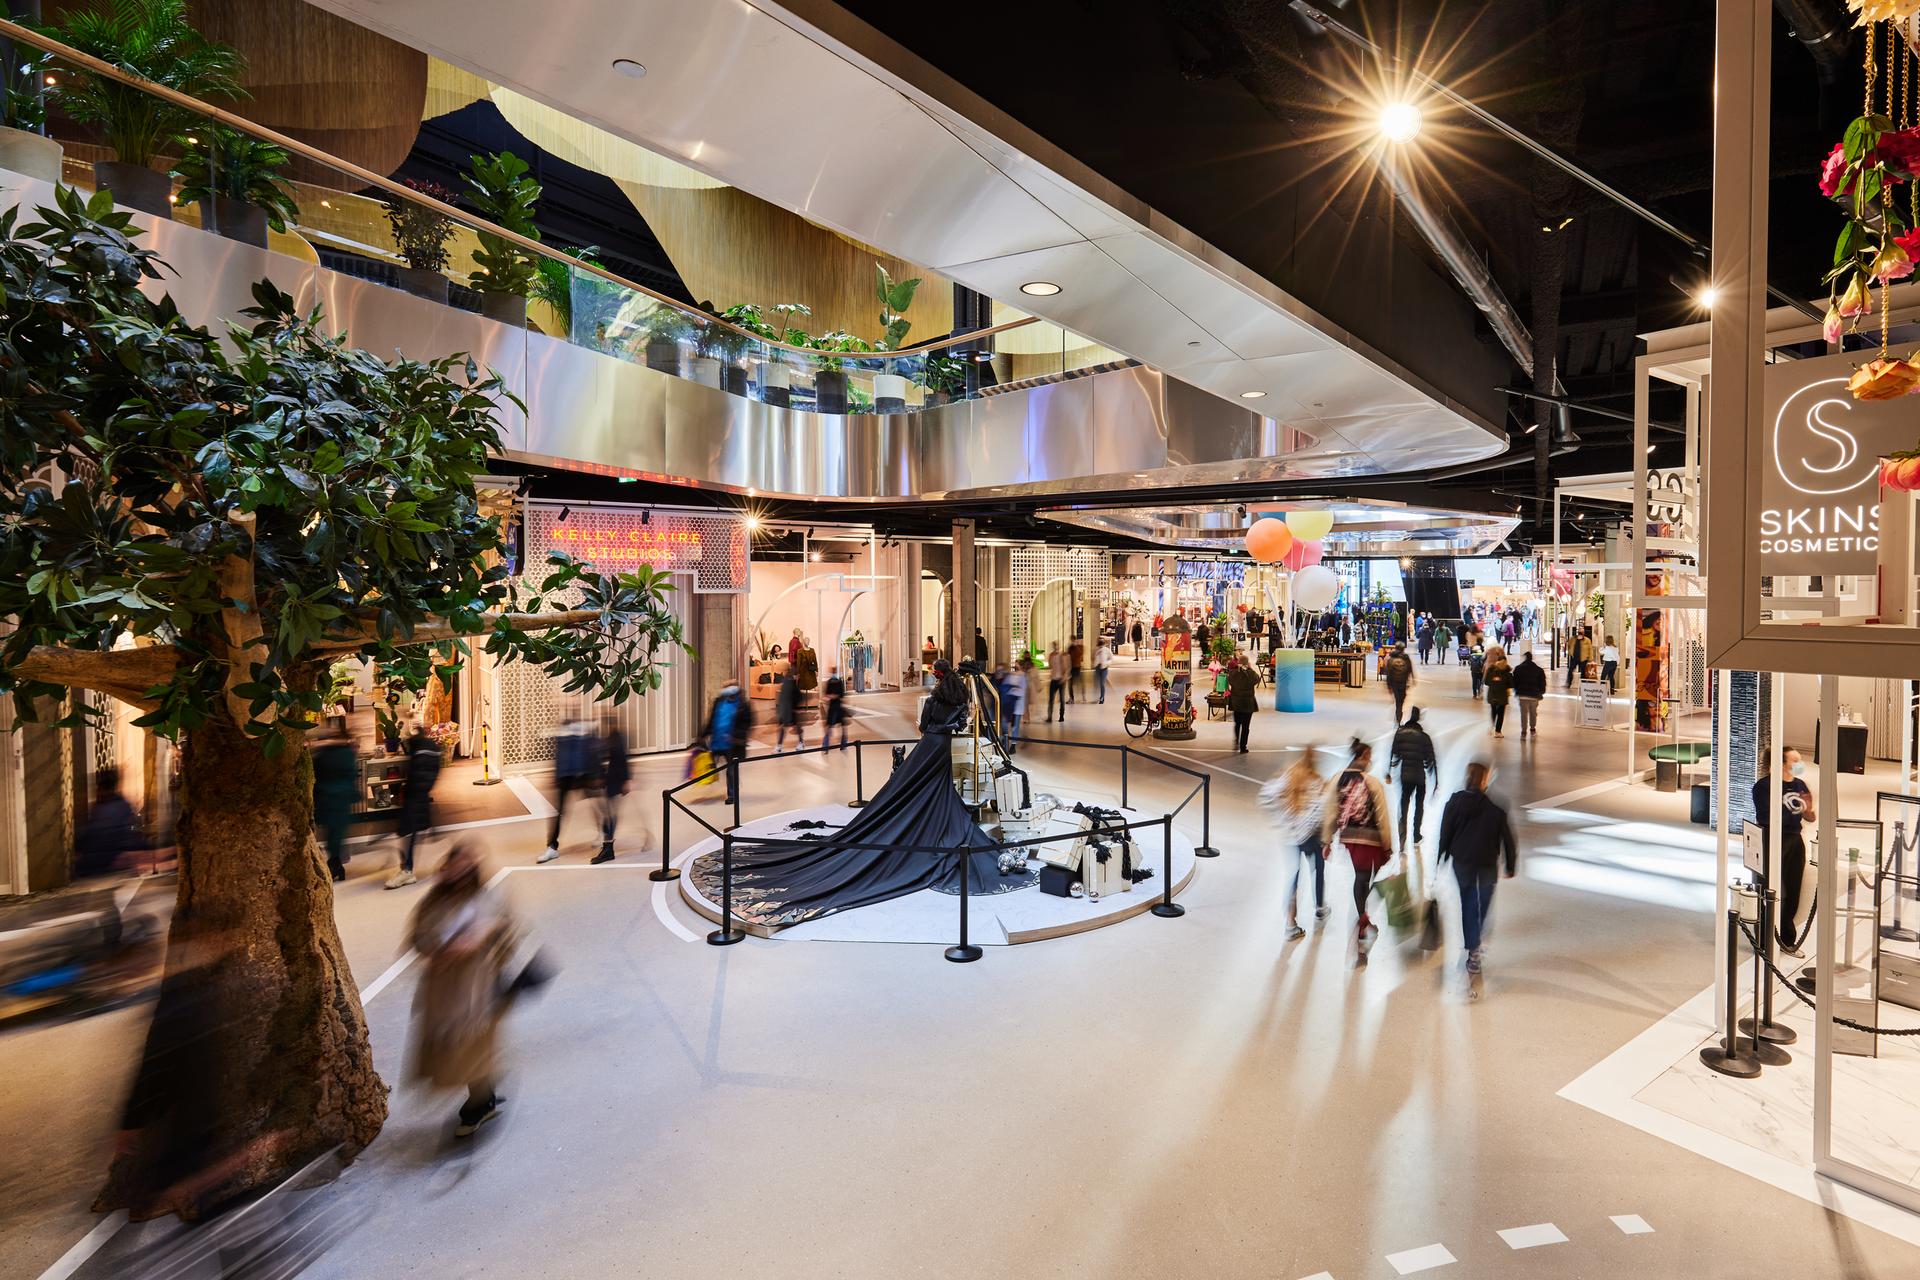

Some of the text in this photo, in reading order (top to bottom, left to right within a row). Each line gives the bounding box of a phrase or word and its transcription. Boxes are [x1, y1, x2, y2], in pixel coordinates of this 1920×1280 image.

[552, 529, 701, 544] KELLY CLAIRE
[1760, 536, 1879, 554] COSMETIC
[587, 547, 672, 561] STUDIOS
